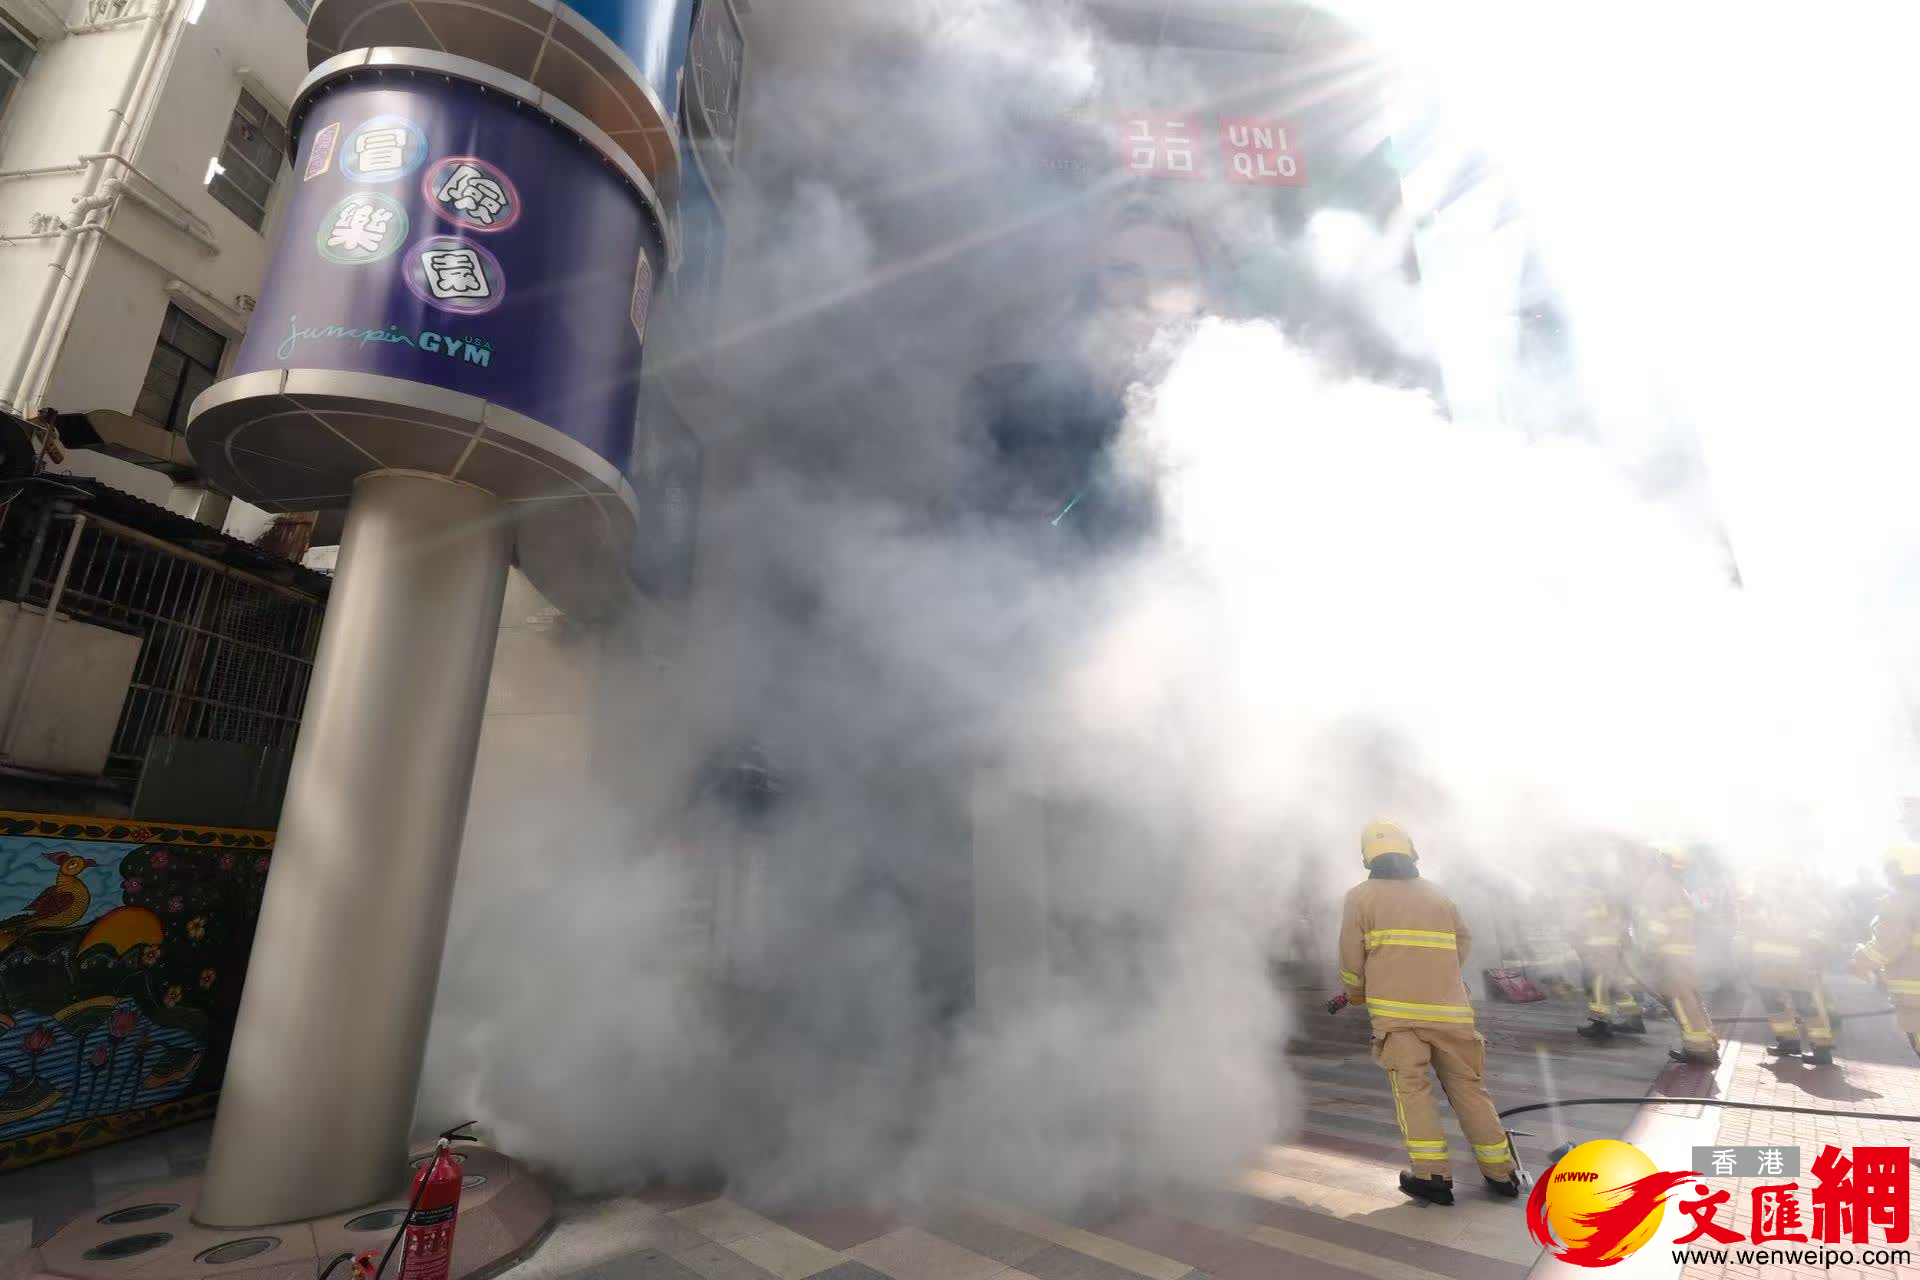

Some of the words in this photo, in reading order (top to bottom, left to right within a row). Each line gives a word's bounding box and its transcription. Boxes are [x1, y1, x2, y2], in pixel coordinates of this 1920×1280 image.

[1228, 124, 1288, 151] UNI
[1233, 151, 1297, 178] QLO
[356, 128, 508, 225] 冒險
[327, 202, 491, 299] 樂園
[277, 314, 415, 361] jumpin
[418, 331, 491, 368] GYM
